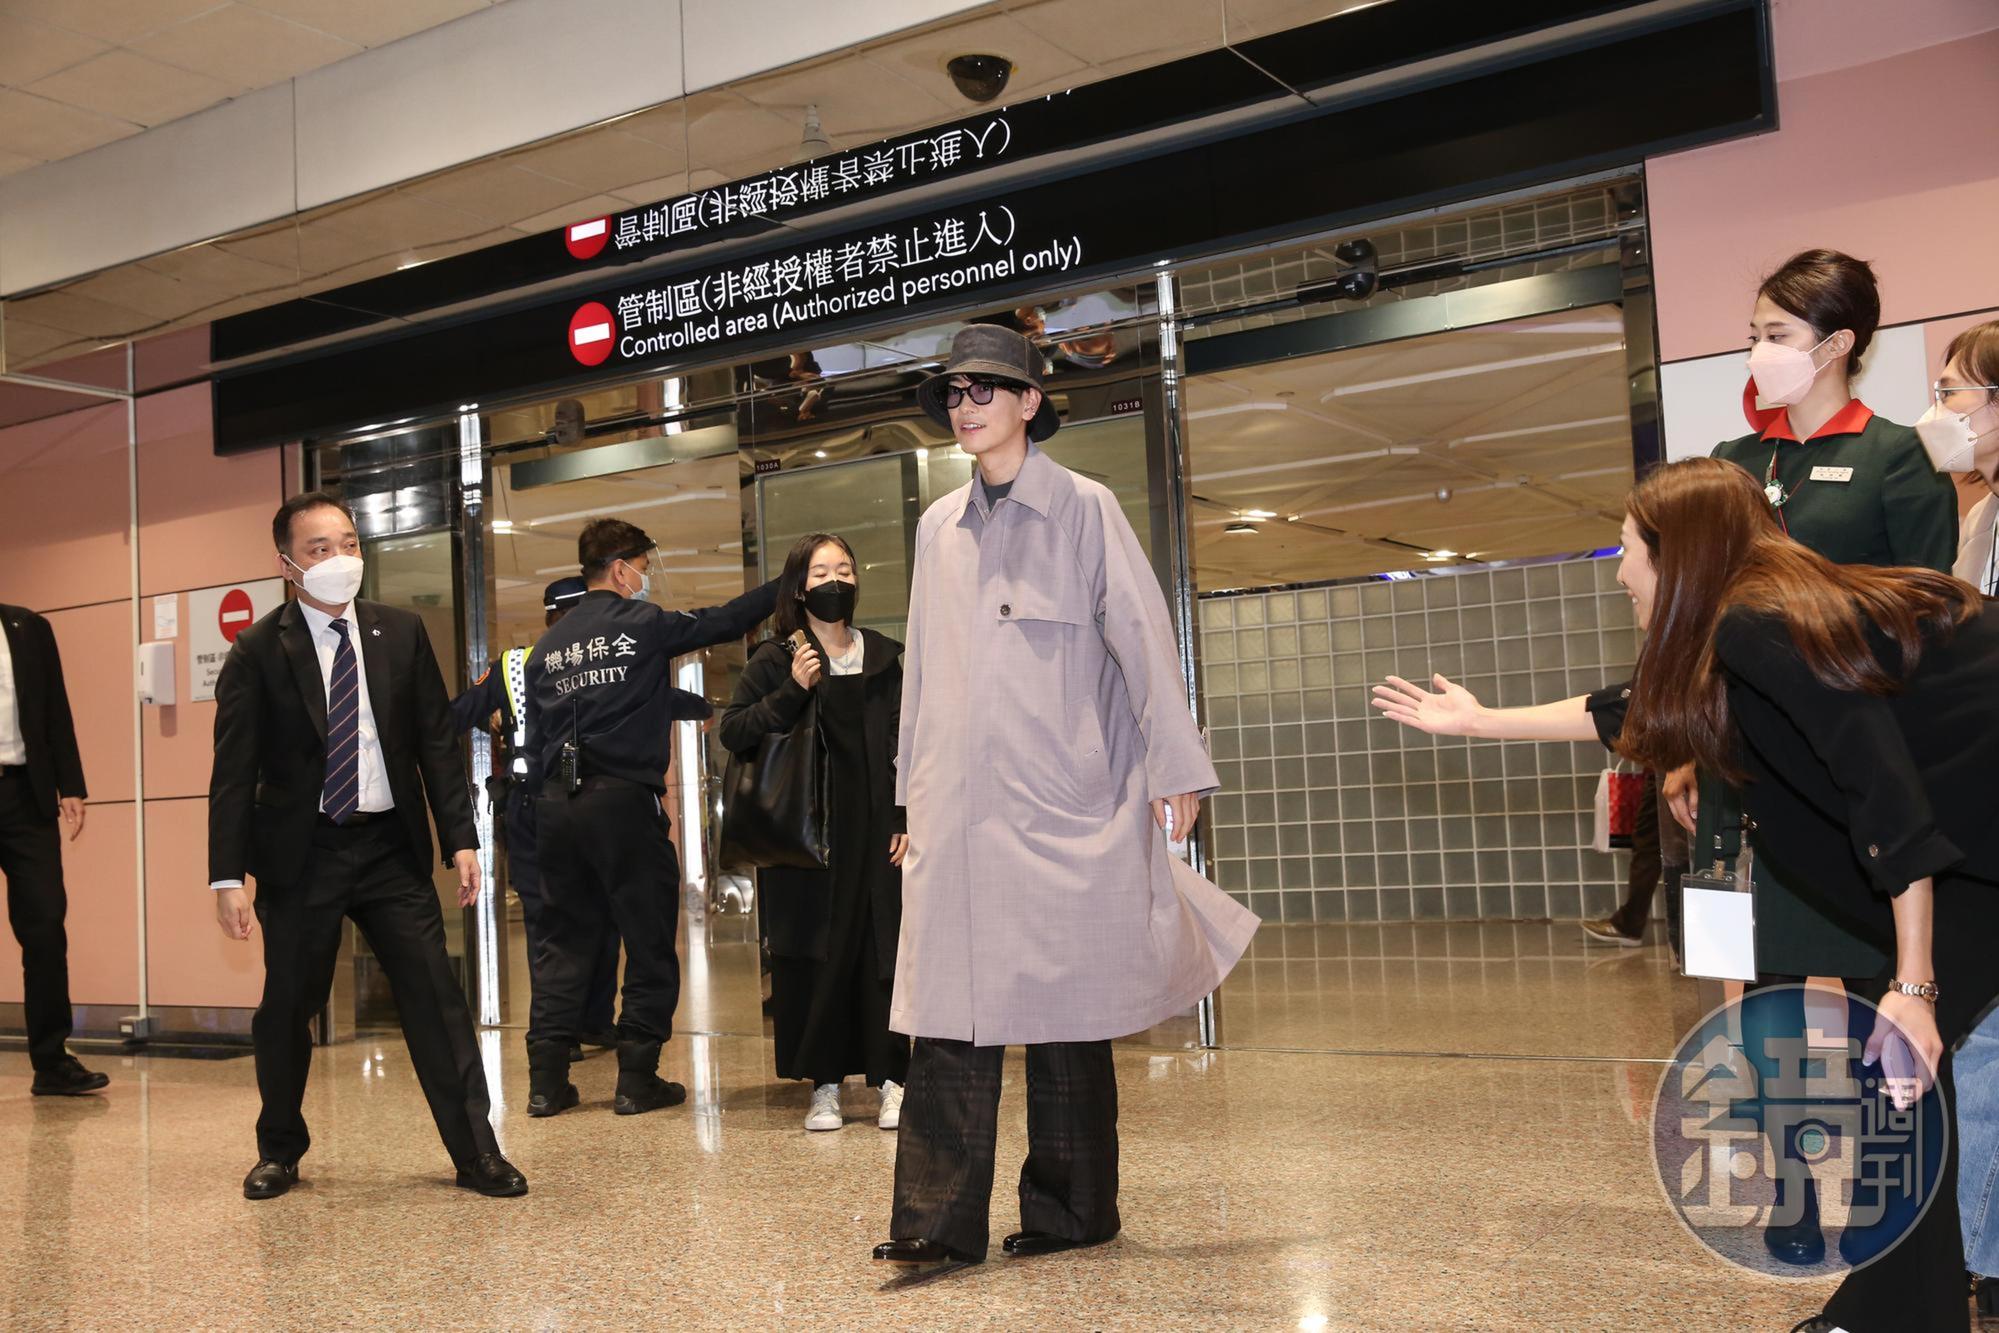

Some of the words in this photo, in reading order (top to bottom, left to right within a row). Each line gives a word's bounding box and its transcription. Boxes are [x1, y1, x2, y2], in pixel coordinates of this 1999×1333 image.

[617, 205, 1015, 331] 管制區(非經授權者禁止進入)
[620, 315, 720, 358] Controlled
[725, 312, 768, 336] area
[772, 277, 895, 329] (Authorized
[902, 249, 1015, 305] personnel
[1022, 235, 1082, 271] only)
[544, 632, 638, 675] 機場保全
[555, 665, 629, 696] SECURITY
